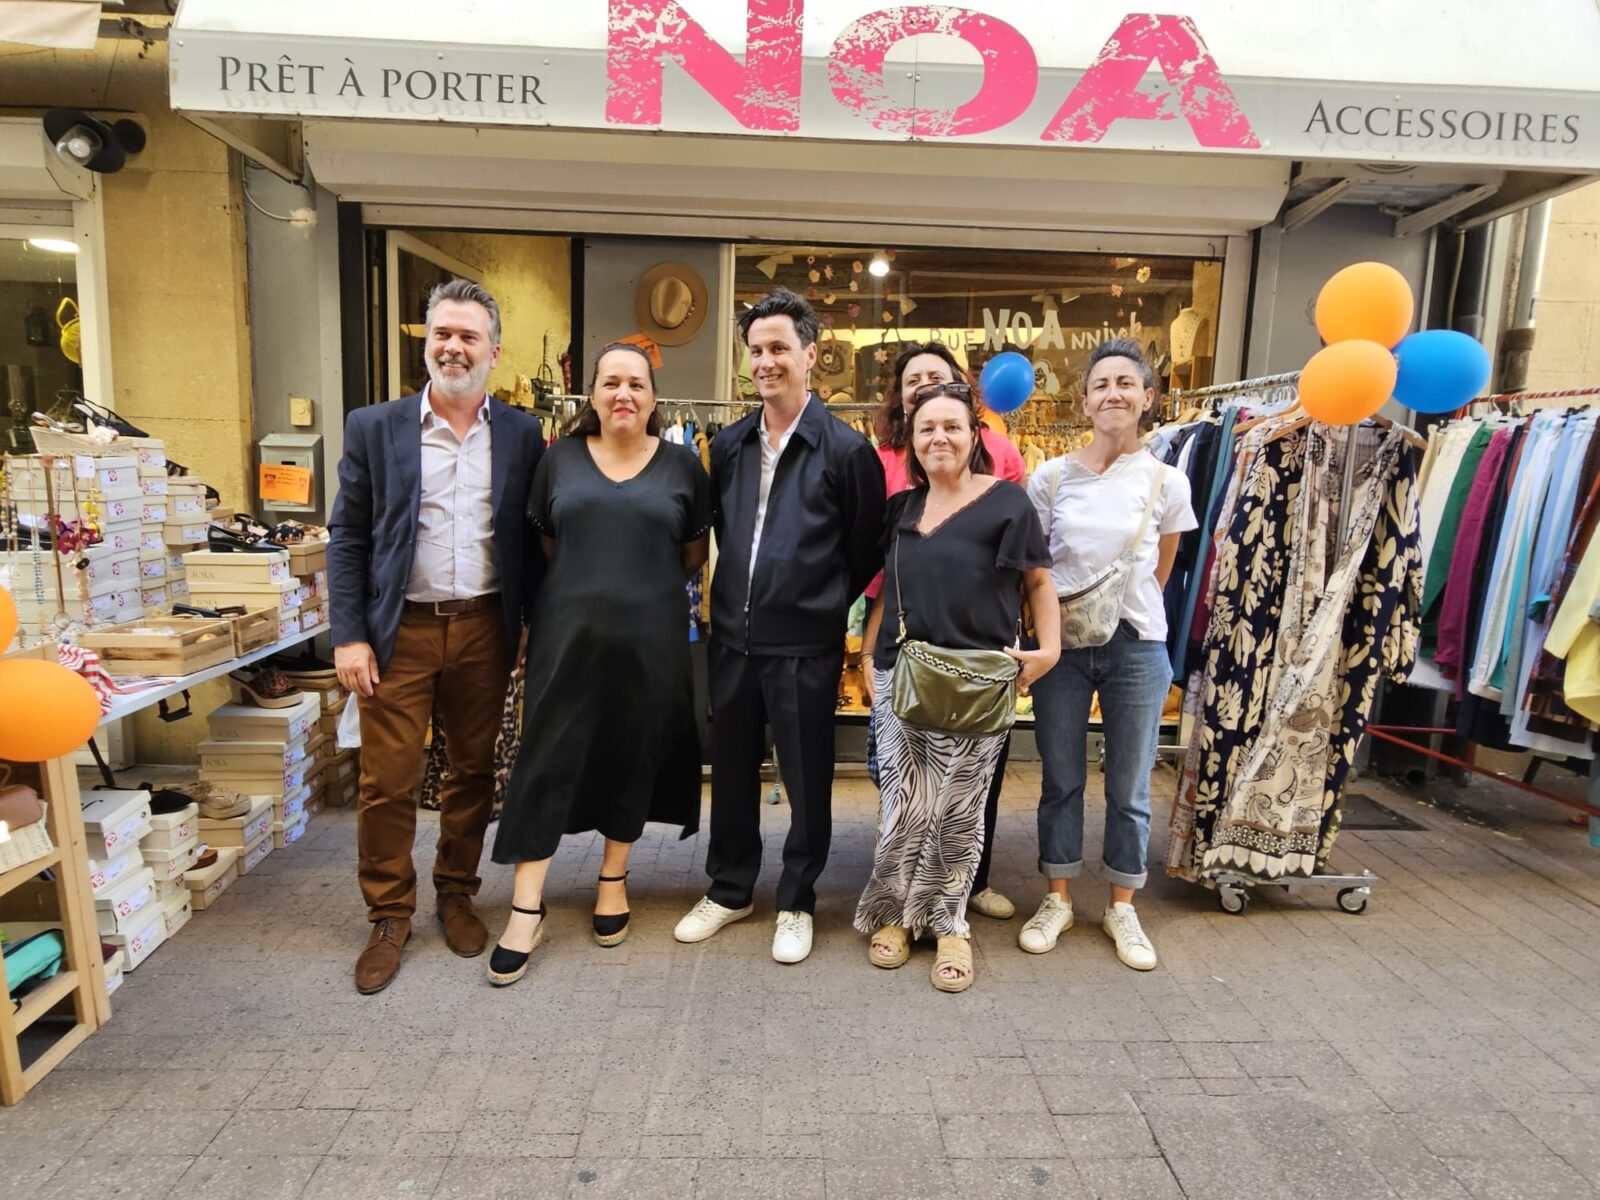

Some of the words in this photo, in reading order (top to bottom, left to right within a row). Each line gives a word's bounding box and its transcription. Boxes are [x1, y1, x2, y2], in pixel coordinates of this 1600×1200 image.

[336, 57, 366, 97] À
[380, 68, 548, 105] PORTER
[606, 0, 1261, 148] NOA
[1303, 99, 1580, 145] ACCESSOIRES
